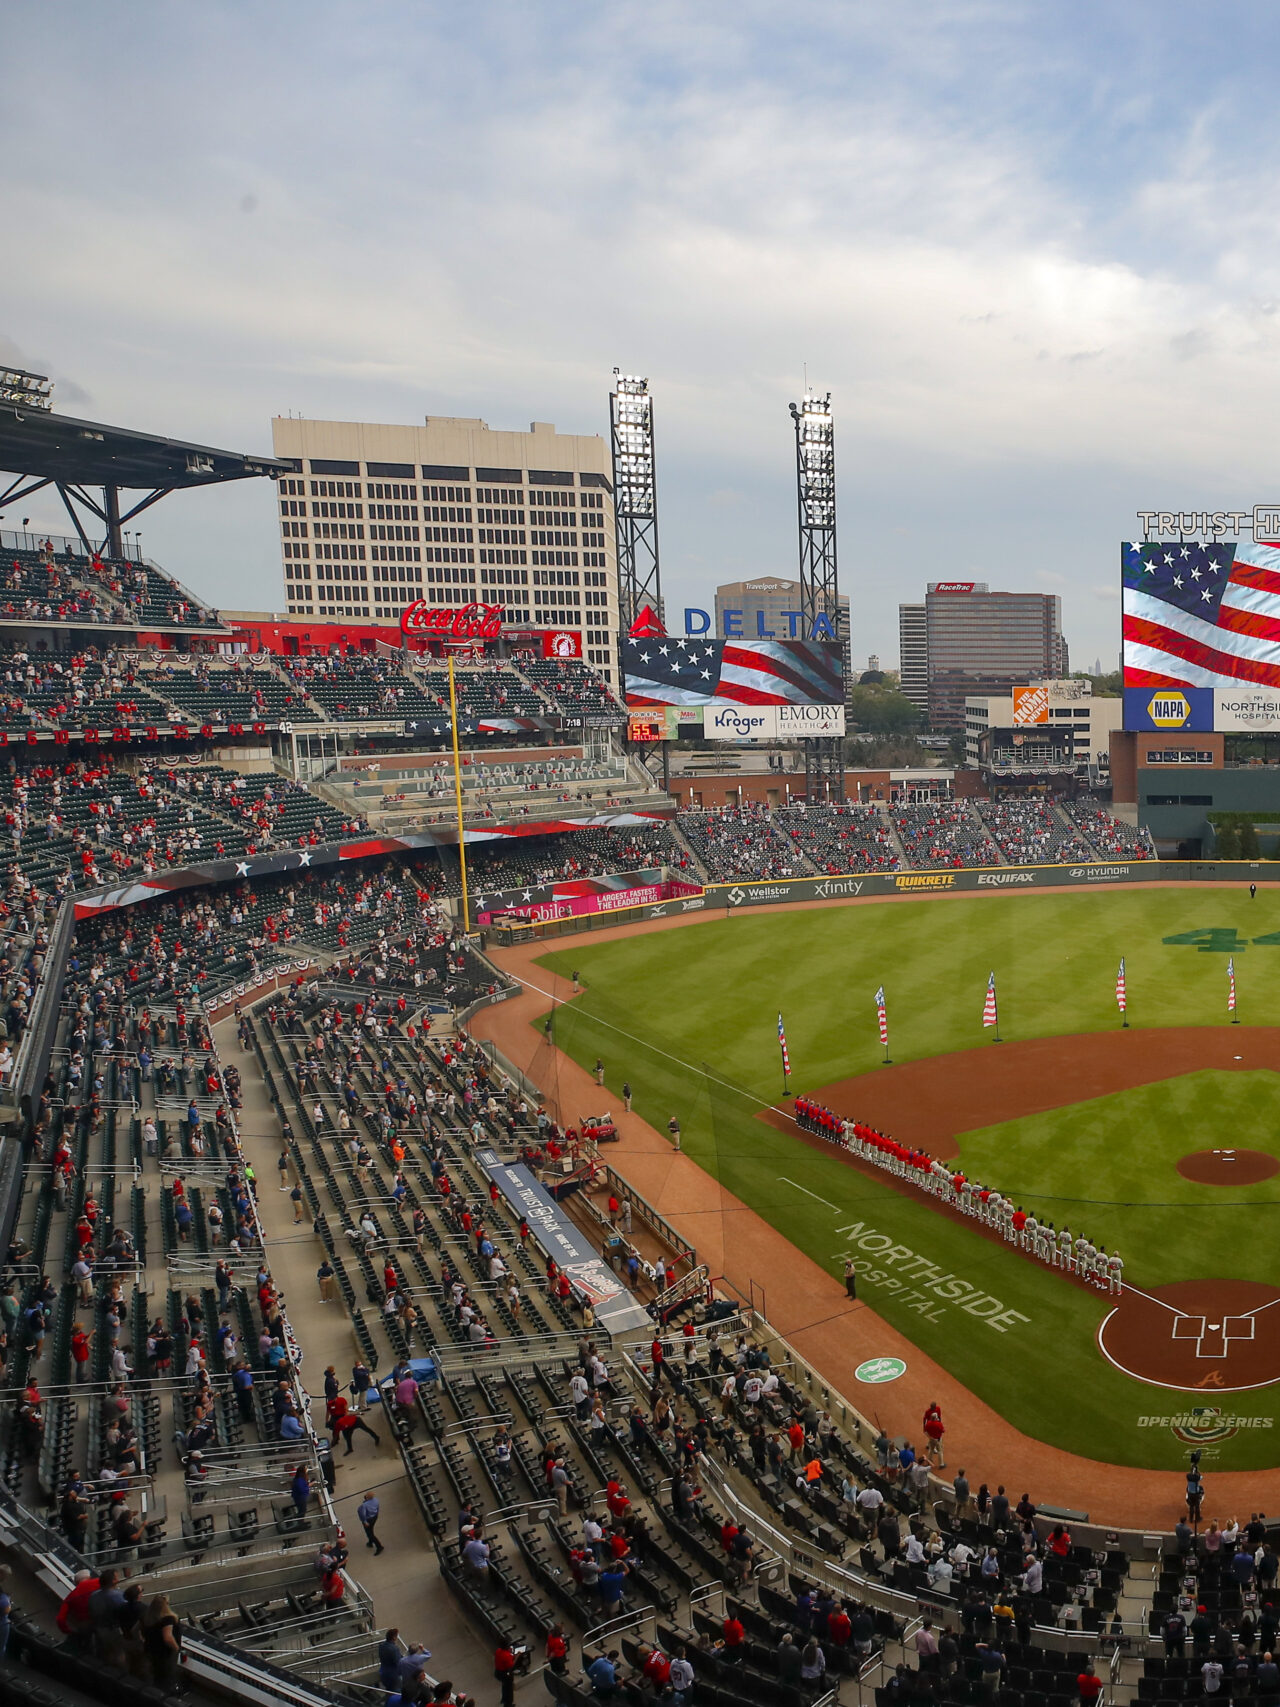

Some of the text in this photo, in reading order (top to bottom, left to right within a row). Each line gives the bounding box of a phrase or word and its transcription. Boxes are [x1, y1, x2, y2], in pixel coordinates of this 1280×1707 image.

[1137, 512, 1247, 536] TRUIST
[746, 583, 778, 591] Travelport
[401, 598, 506, 638] Coca-Cola
[684, 608, 837, 638] DELTA
[1013, 687, 1048, 723] HOME
[1016, 691, 1032, 706] THE
[780, 706, 841, 720] EMORY
[1027, 700, 1048, 723] DEPOT
[1154, 701, 1185, 718] NAPA
[252, 722, 266, 735] 47
[279, 722, 293, 733] 42
[566, 719, 581, 727] 7:18
[715, 708, 766, 735] Kroger
[84, 728, 100, 743] 21
[112, 727, 131, 741] 29
[144, 726, 159, 740] 31
[173, 725, 189, 739] 35
[201, 725, 213, 737] 41
[228, 723, 243, 736] 44
[632, 724, 650, 735] 55
[26, 730, 38, 746] 6
[53, 730, 69, 744] 10
[1087, 867, 1129, 876] HYUNDAI
[896, 875, 955, 886] QUIKRETE
[977, 873, 1035, 886] EQUIFAX
[597, 888, 657, 902] LARGEST. FASTEST.
[748, 887, 790, 897] Wellstar
[814, 880, 863, 898] xfinity
[598, 894, 657, 910] THE LEADER IN 5G
[538, 1215, 563, 1233] PARK
[834, 1221, 1032, 1333] NORTHSIDE
[831, 1251, 947, 1324] HOSPITAL
[1137, 1416, 1274, 1428] OPENING SERIES
